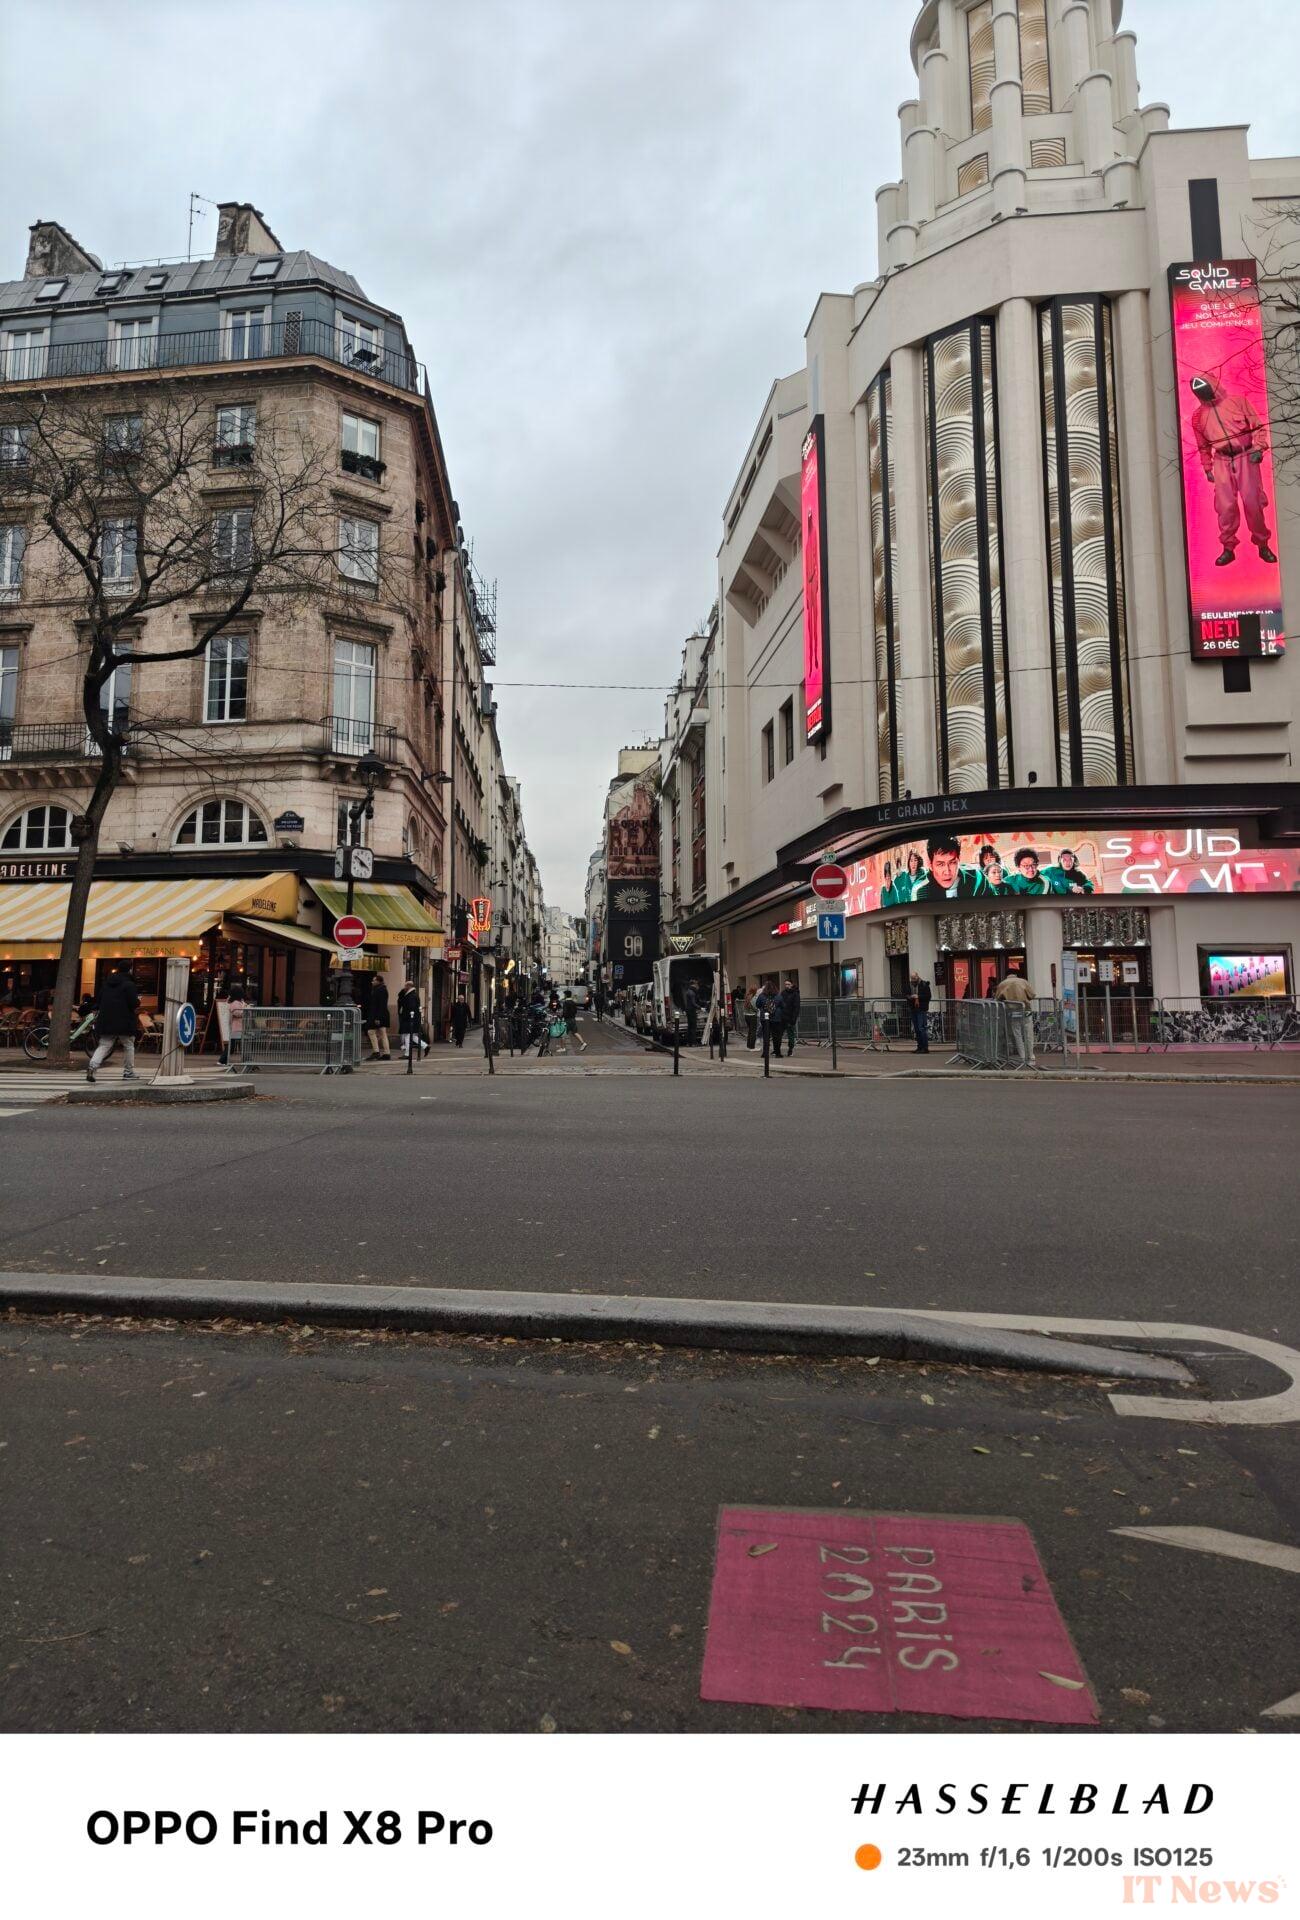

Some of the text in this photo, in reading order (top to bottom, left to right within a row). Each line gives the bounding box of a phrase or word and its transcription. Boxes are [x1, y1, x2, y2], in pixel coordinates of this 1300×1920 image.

[1175, 262, 1230, 284] SQUID
[1203, 638, 1240, 650] 26 DÉC
[878, 798, 969, 821] LE GRAND REX
[251, 897, 277, 913] MADELEINE
[392, 933, 435, 947] RESTAURANT
[624, 935, 643, 957] 90
[820, 1544, 882, 1669] 2024
